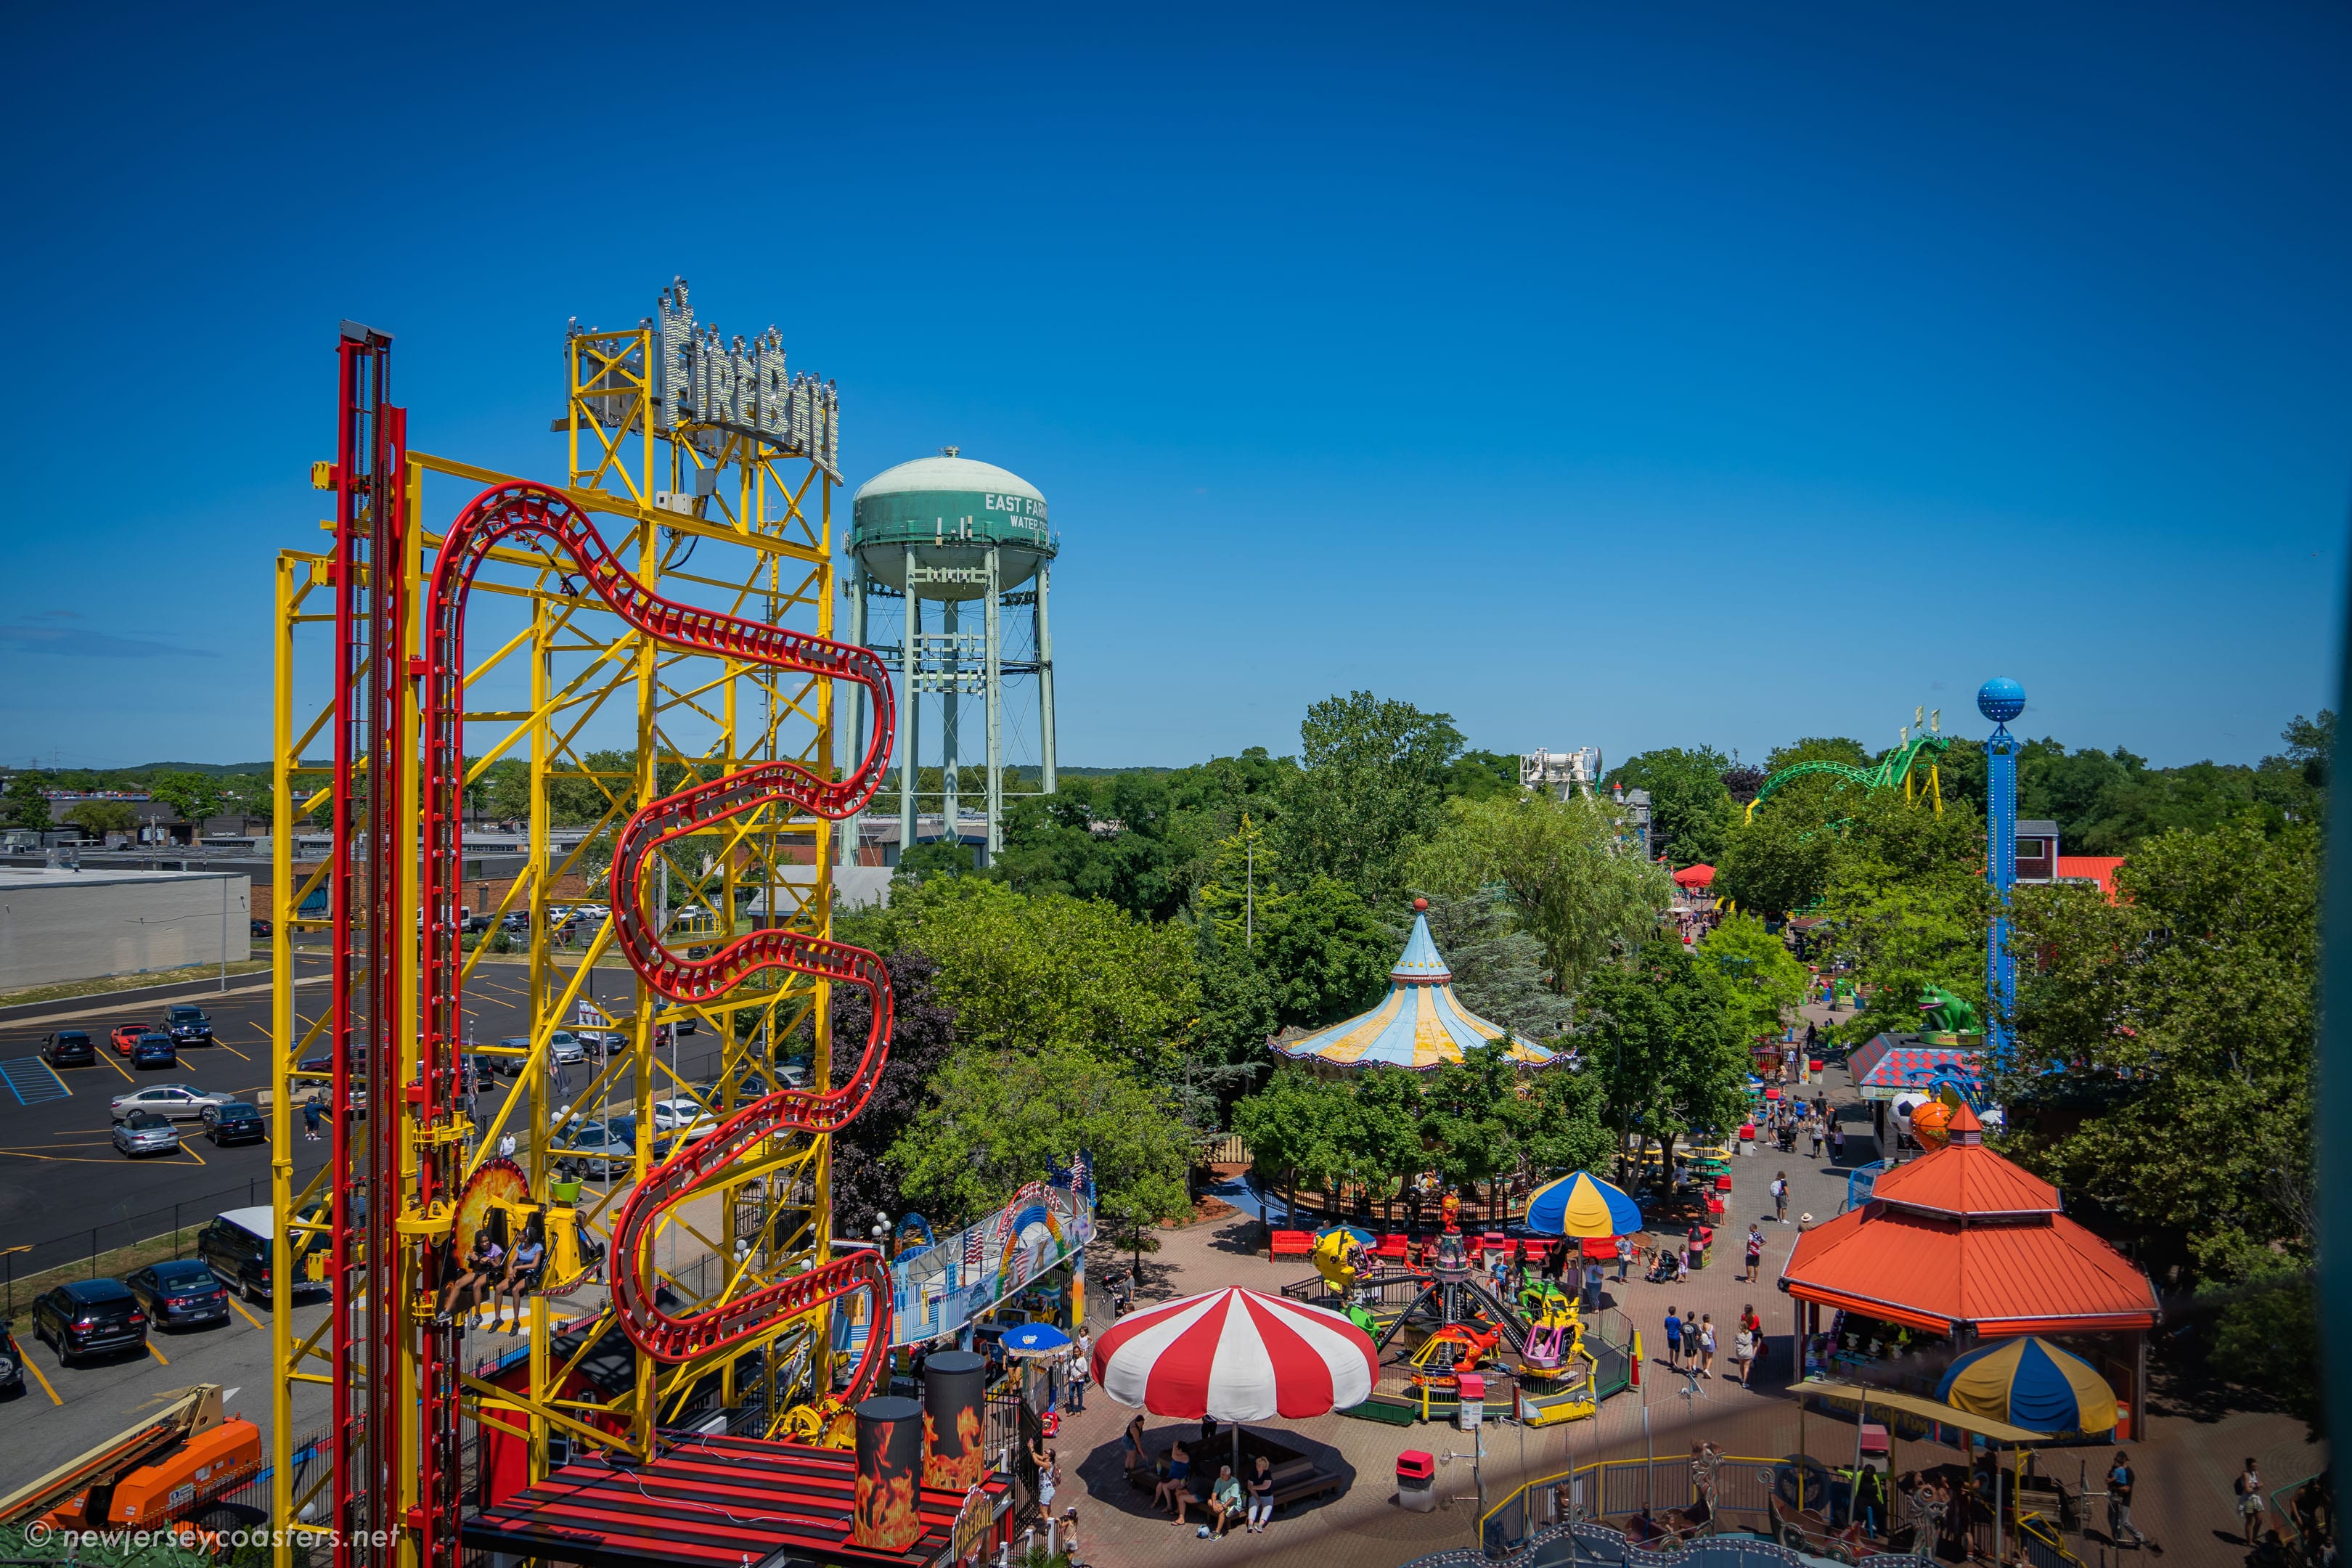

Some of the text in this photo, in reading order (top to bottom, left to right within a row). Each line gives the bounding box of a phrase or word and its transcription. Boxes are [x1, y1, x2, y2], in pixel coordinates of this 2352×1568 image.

[658, 274, 844, 486] FIREBALL
[985, 494, 1022, 513] EAST
[1010, 515, 1038, 531] WATER
[955, 1500, 994, 1562] FIREBALL
